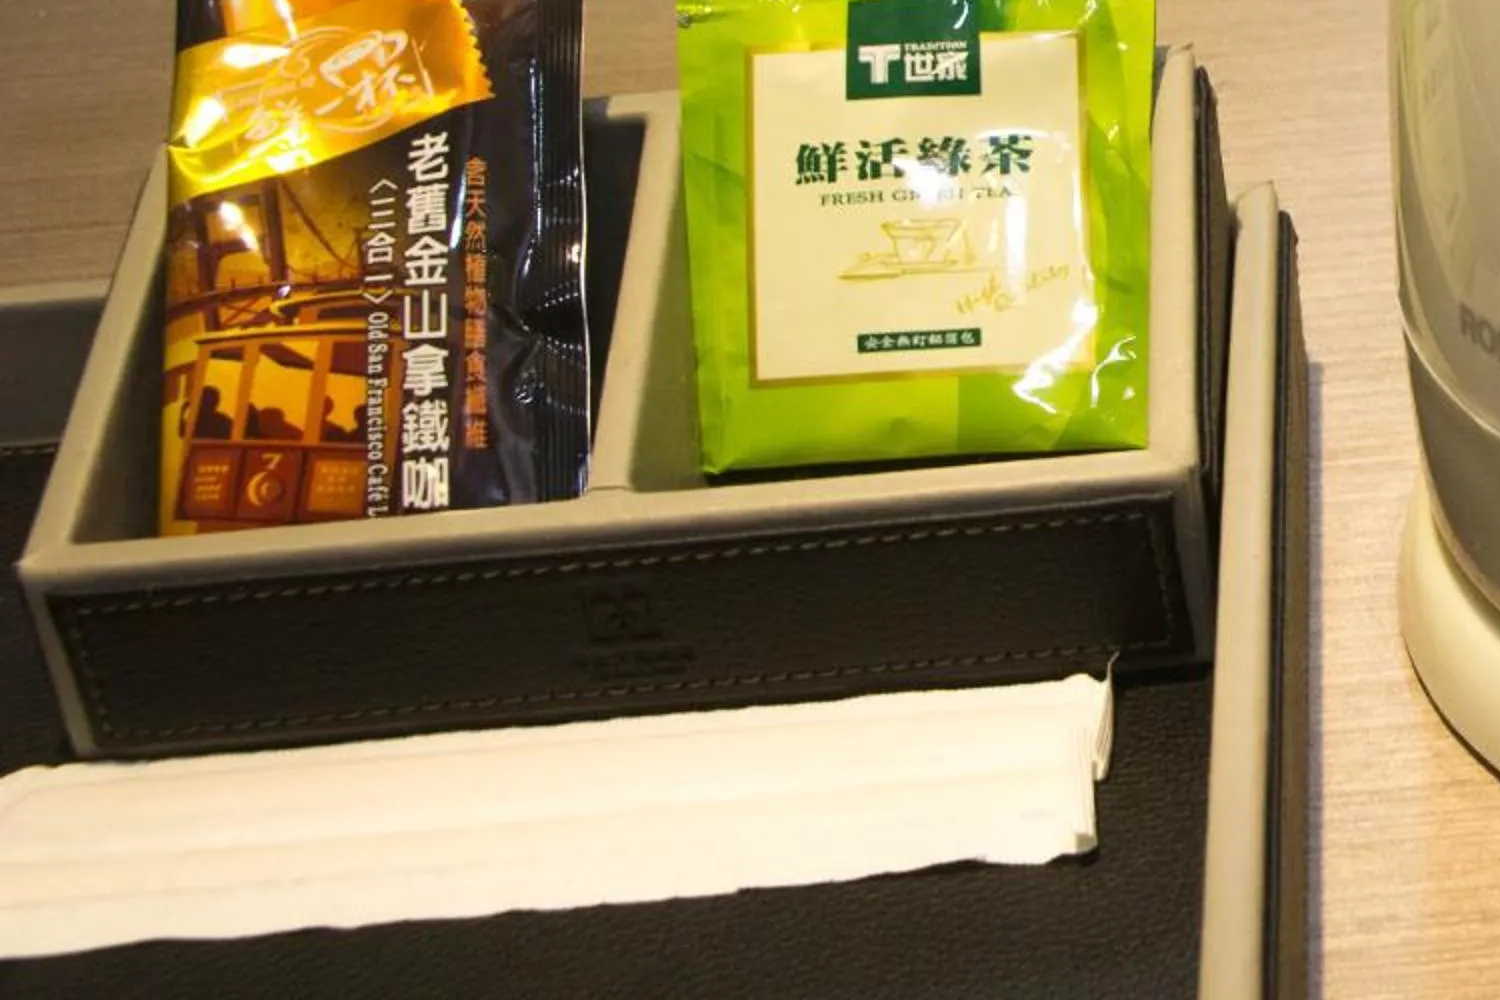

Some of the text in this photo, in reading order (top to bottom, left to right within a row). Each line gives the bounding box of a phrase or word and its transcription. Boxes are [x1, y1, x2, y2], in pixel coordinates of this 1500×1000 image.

[796, 133, 1033, 185] 鮮活綠茶
[820, 188, 884, 207] FRESH
[368, 312, 389, 340] Old
[402, 131, 450, 510] 老舊金山拿鐵咖
[368, 343, 389, 375] San
[368, 377, 389, 461] Francisco
[368, 463, 389, 501] Café
